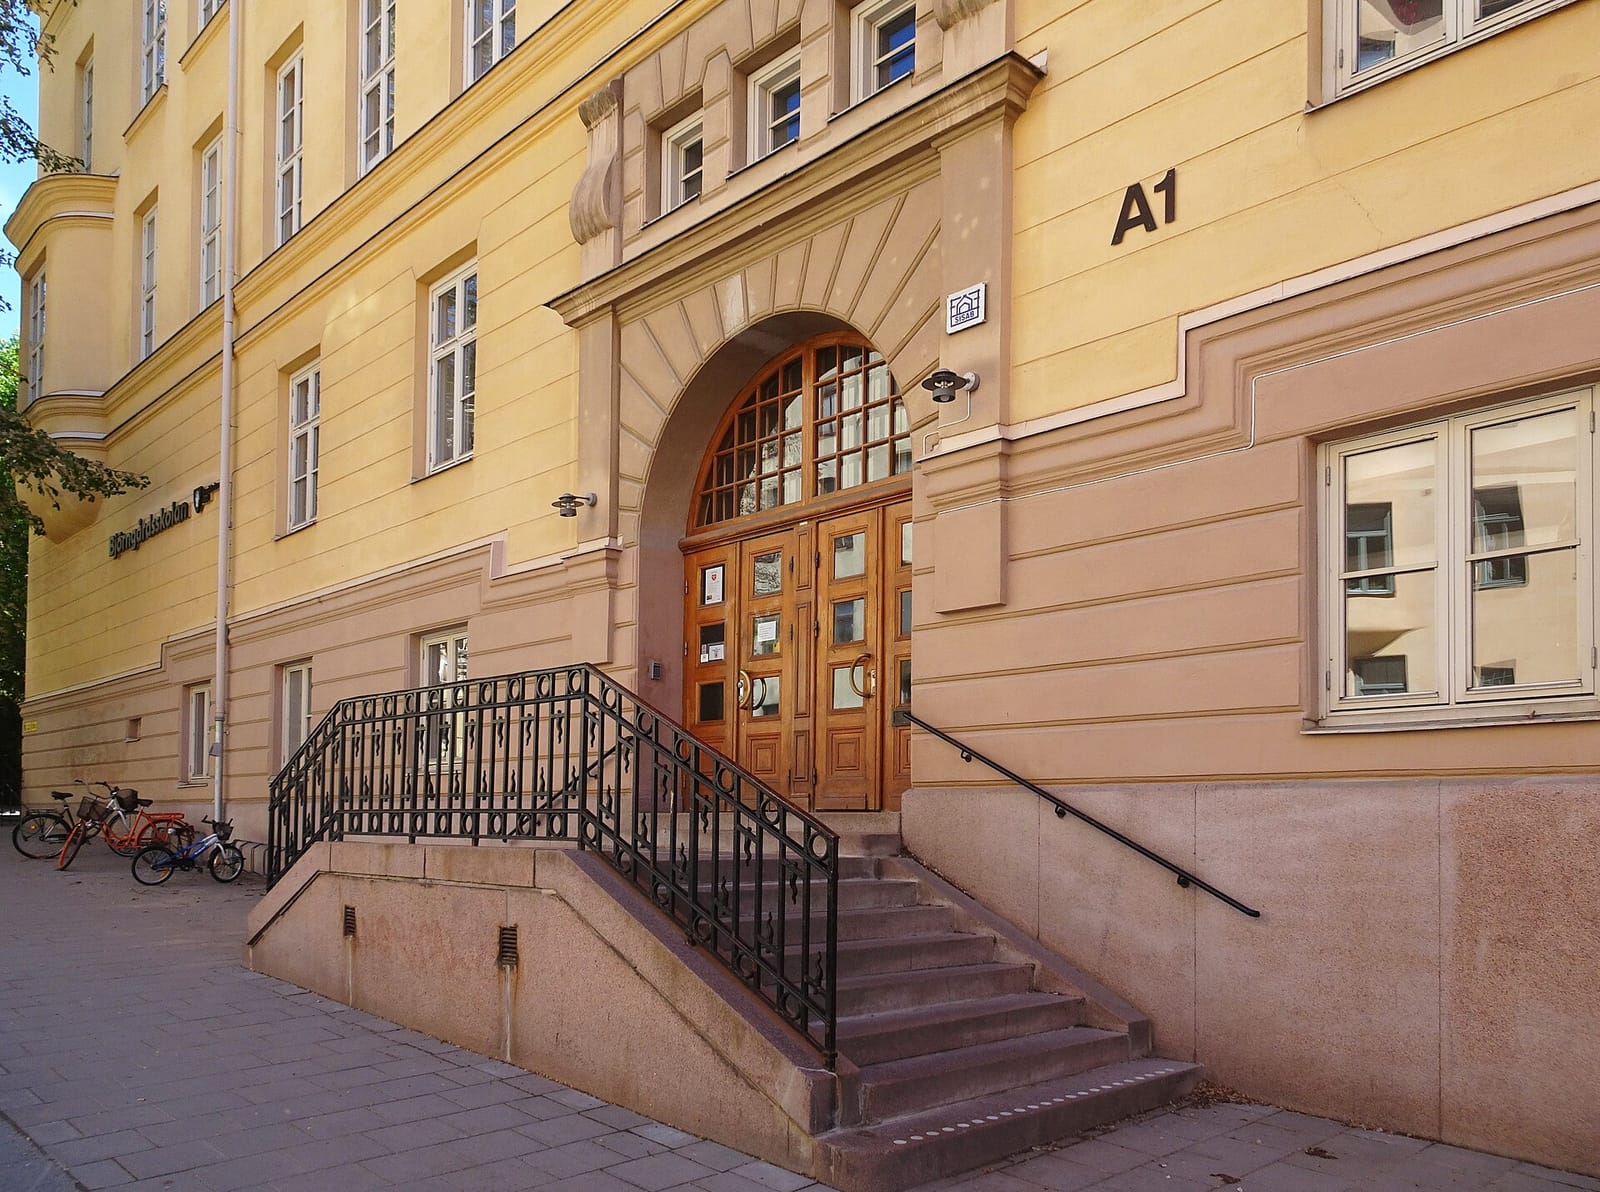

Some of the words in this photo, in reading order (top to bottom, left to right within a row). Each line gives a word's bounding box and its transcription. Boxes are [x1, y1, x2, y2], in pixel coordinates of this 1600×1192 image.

[1111, 168, 1176, 246] A1
[954, 310, 975, 324] SISAB
[109, 501, 189, 560] Björngårdsskolan
